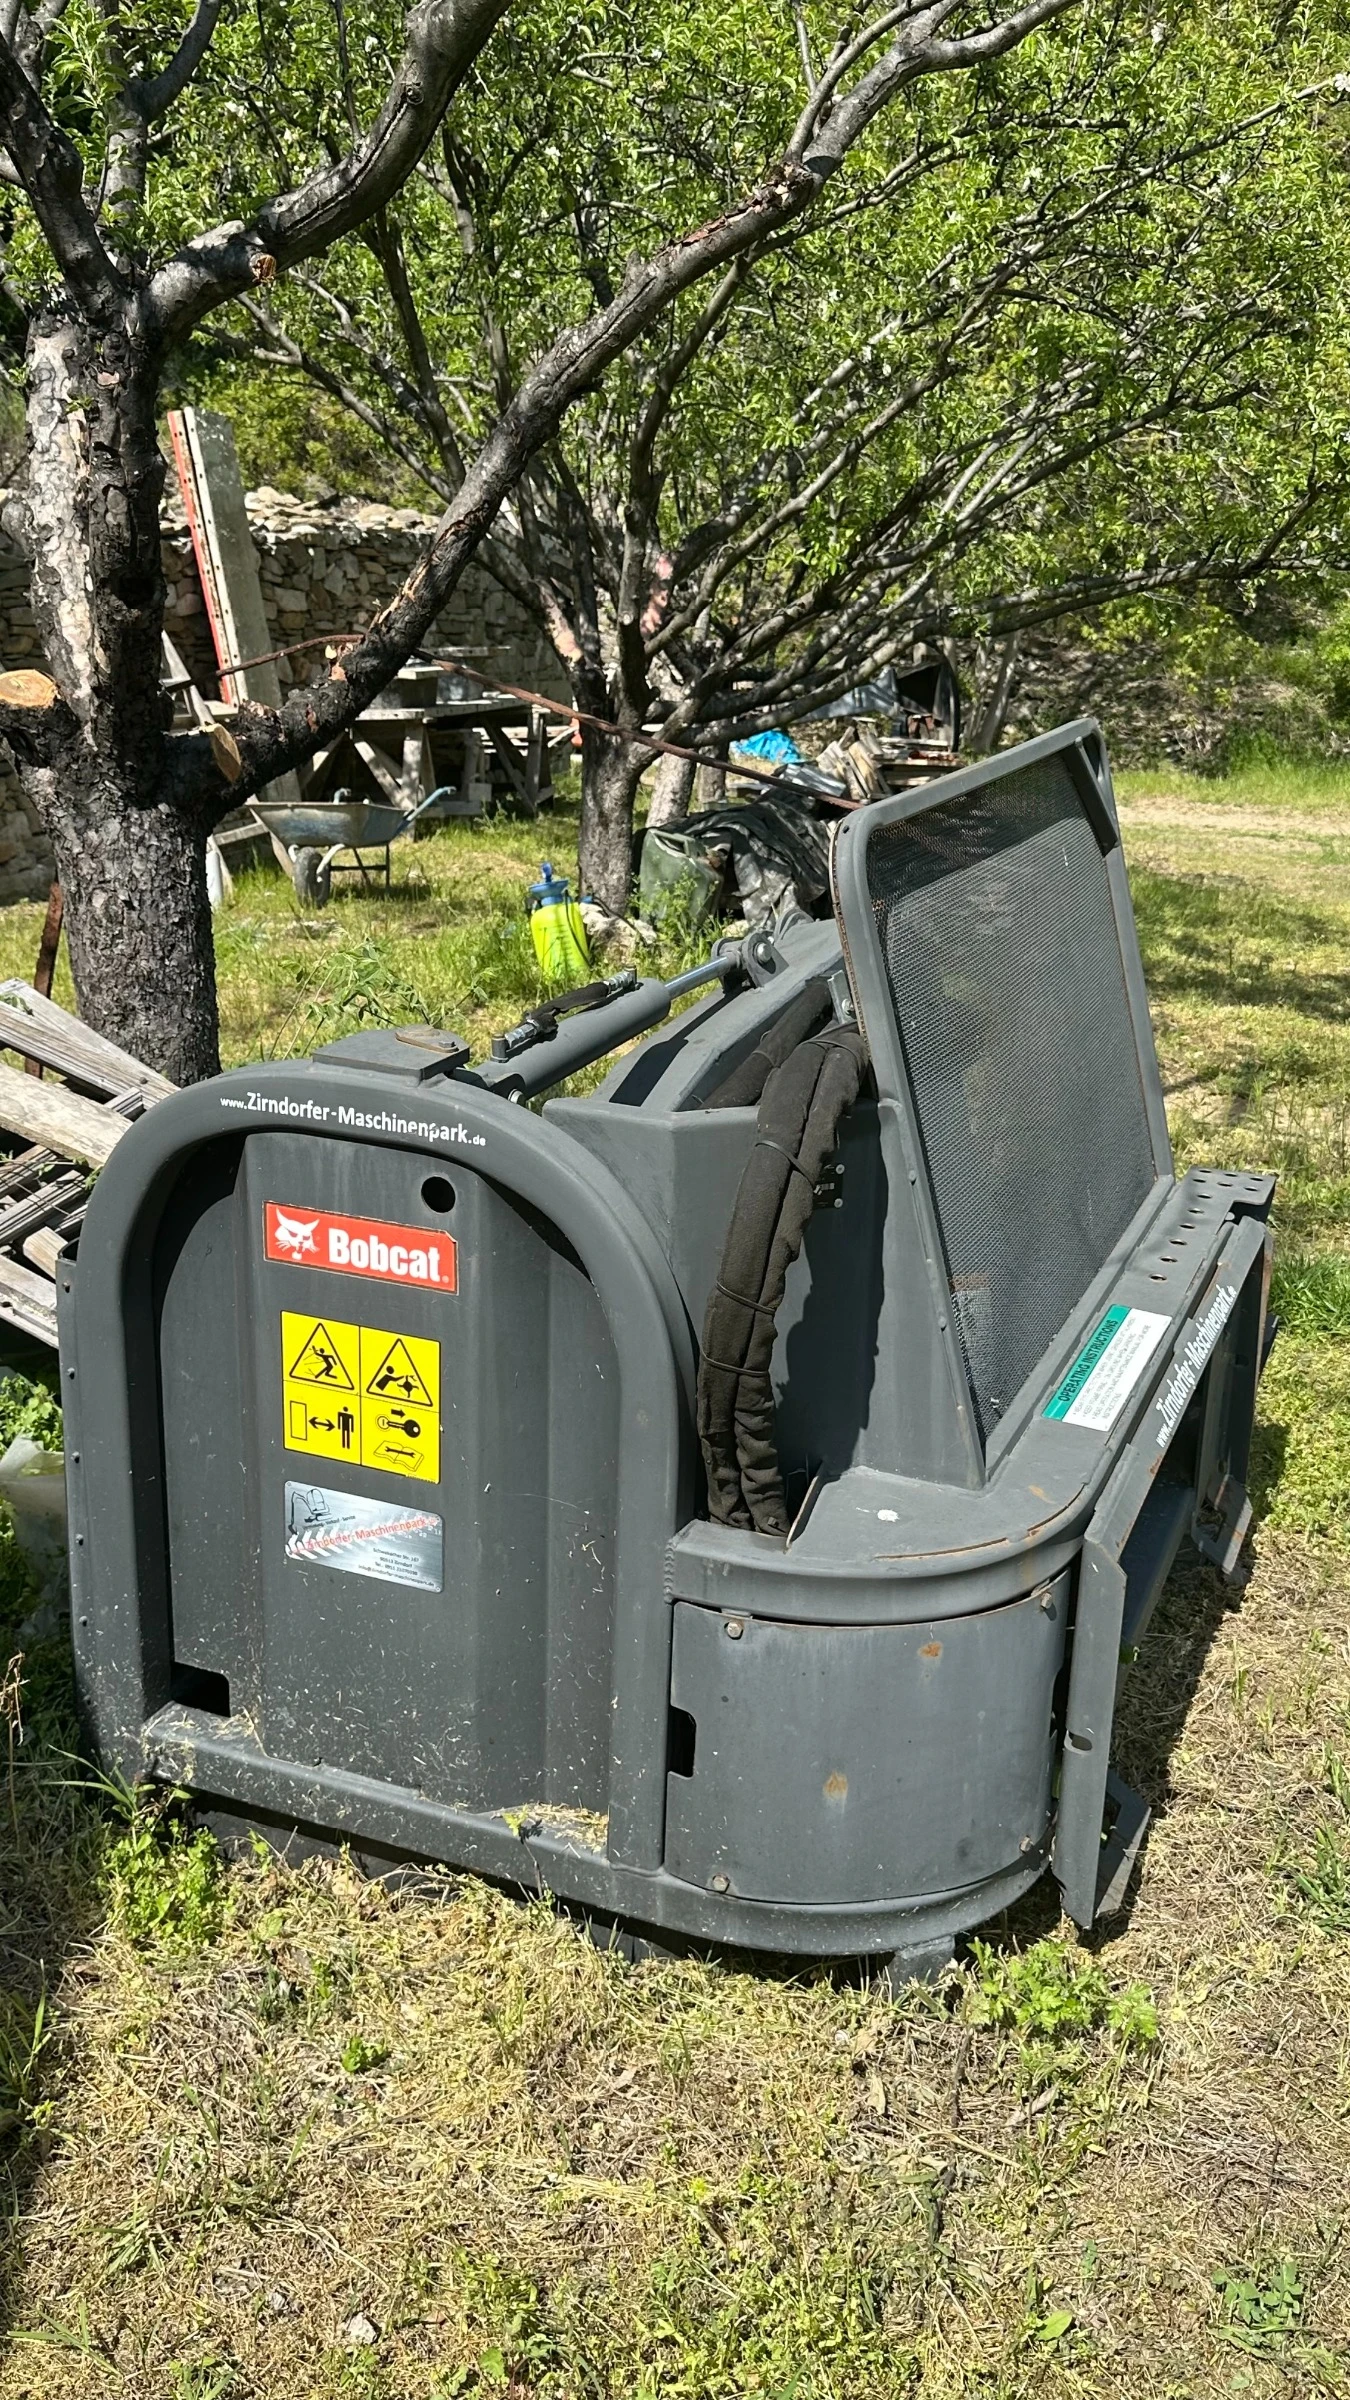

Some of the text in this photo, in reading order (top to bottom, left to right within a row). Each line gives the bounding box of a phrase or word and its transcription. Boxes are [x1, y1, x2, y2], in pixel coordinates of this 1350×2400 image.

[219, 1091, 487, 1147] www.Zirndorfer-Maschinenpark.de
[1058, 1363, 1091, 1402] OPERATING
[1083, 1319, 1119, 1364] INSTRUCTIONS
[1155, 1284, 1237, 1448] www.Zirndorfer-Maschinenpark.de
